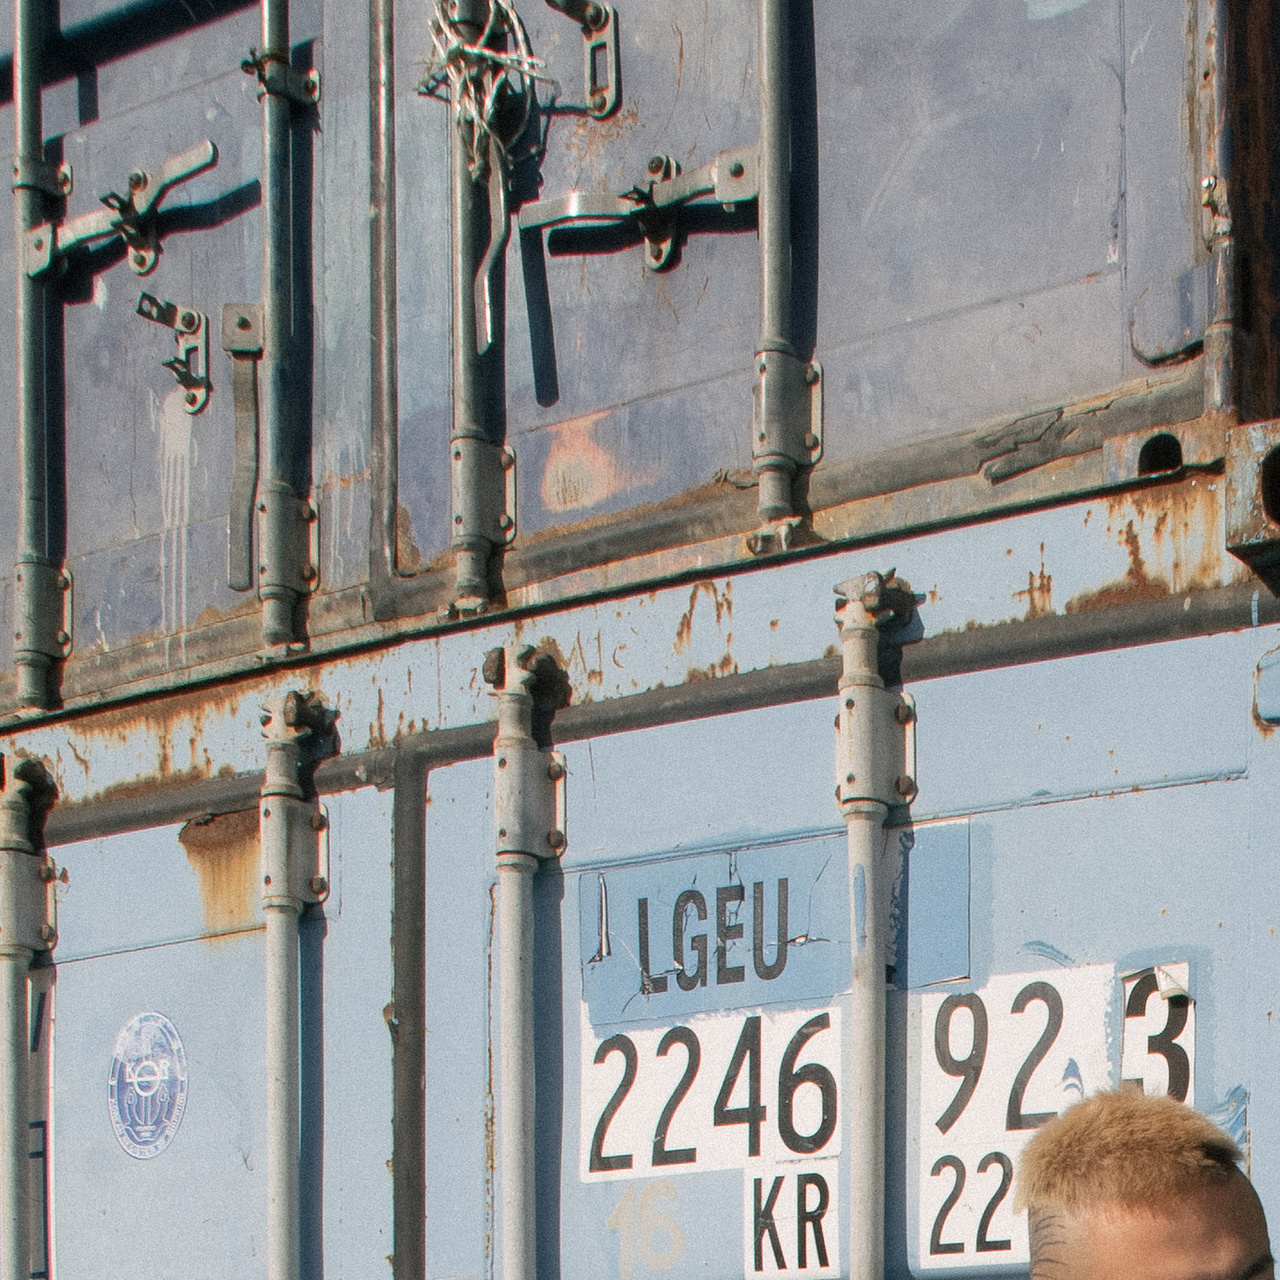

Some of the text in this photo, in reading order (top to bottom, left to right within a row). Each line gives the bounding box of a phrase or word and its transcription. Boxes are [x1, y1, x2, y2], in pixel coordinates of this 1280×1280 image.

[638, 878, 791, 996] LGEU
[588, 966, 1190, 1174] 2246 92 3
[753, 1151, 1013, 1272] KR 22
